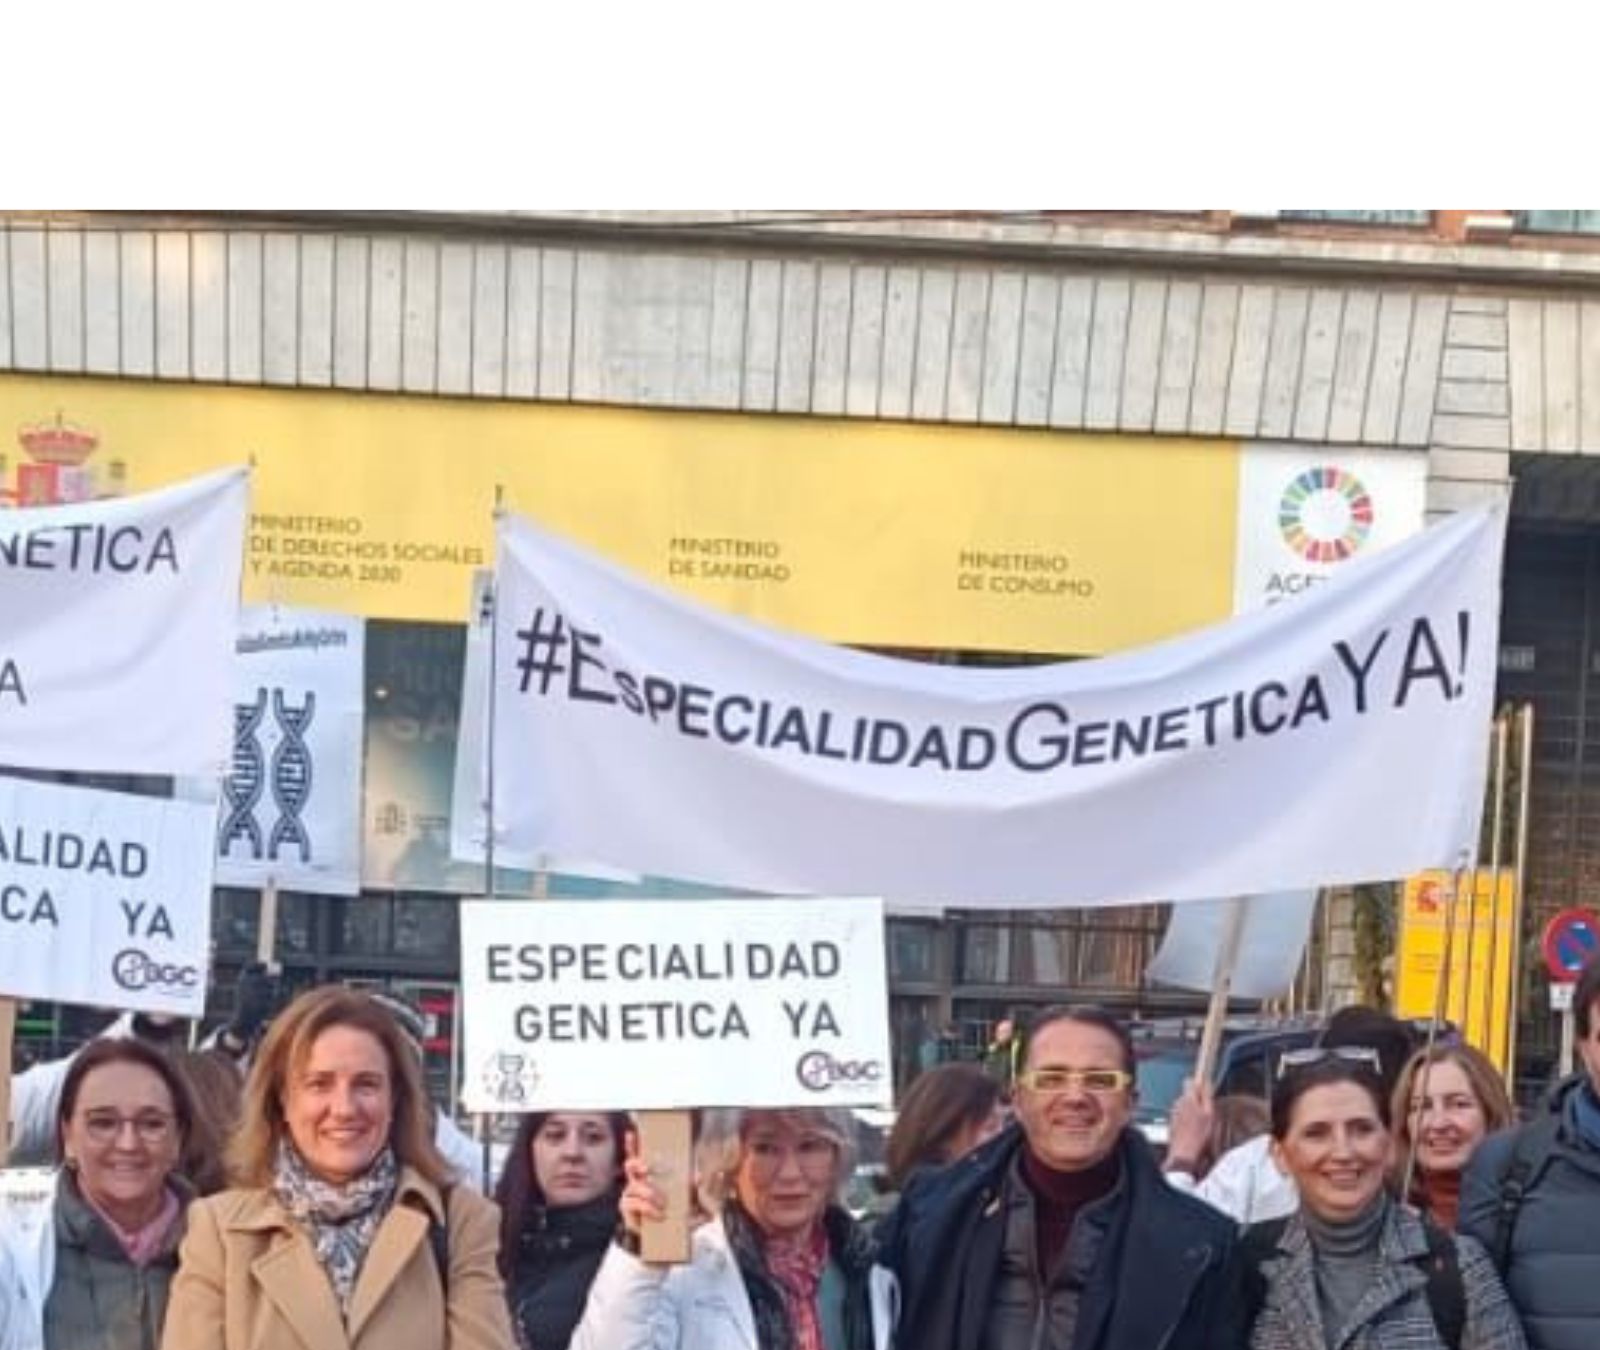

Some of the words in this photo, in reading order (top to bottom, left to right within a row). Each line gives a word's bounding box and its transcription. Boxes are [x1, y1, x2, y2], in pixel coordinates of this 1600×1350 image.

[250, 513, 362, 535] MINISTERIO
[250, 535, 275, 552] DE
[282, 538, 387, 560] DERECHOS
[394, 543, 484, 565] SOCIALES
[669, 537, 780, 559] MINISTERIO
[250, 561, 262, 575] Y
[268, 561, 351, 579] AGENDA
[668, 559, 695, 576] DE
[700, 561, 791, 581] SANIDAD
[958, 551, 1068, 573] MINISTERIO
[957, 574, 984, 592] DE
[990, 576, 1095, 597] CONSUMO
[120, 899, 174, 941] YA
[486, 941, 842, 982] ESPECIALIDAD
[514, 1001, 751, 1042] GENETICA
[783, 1002, 842, 1039] YA
